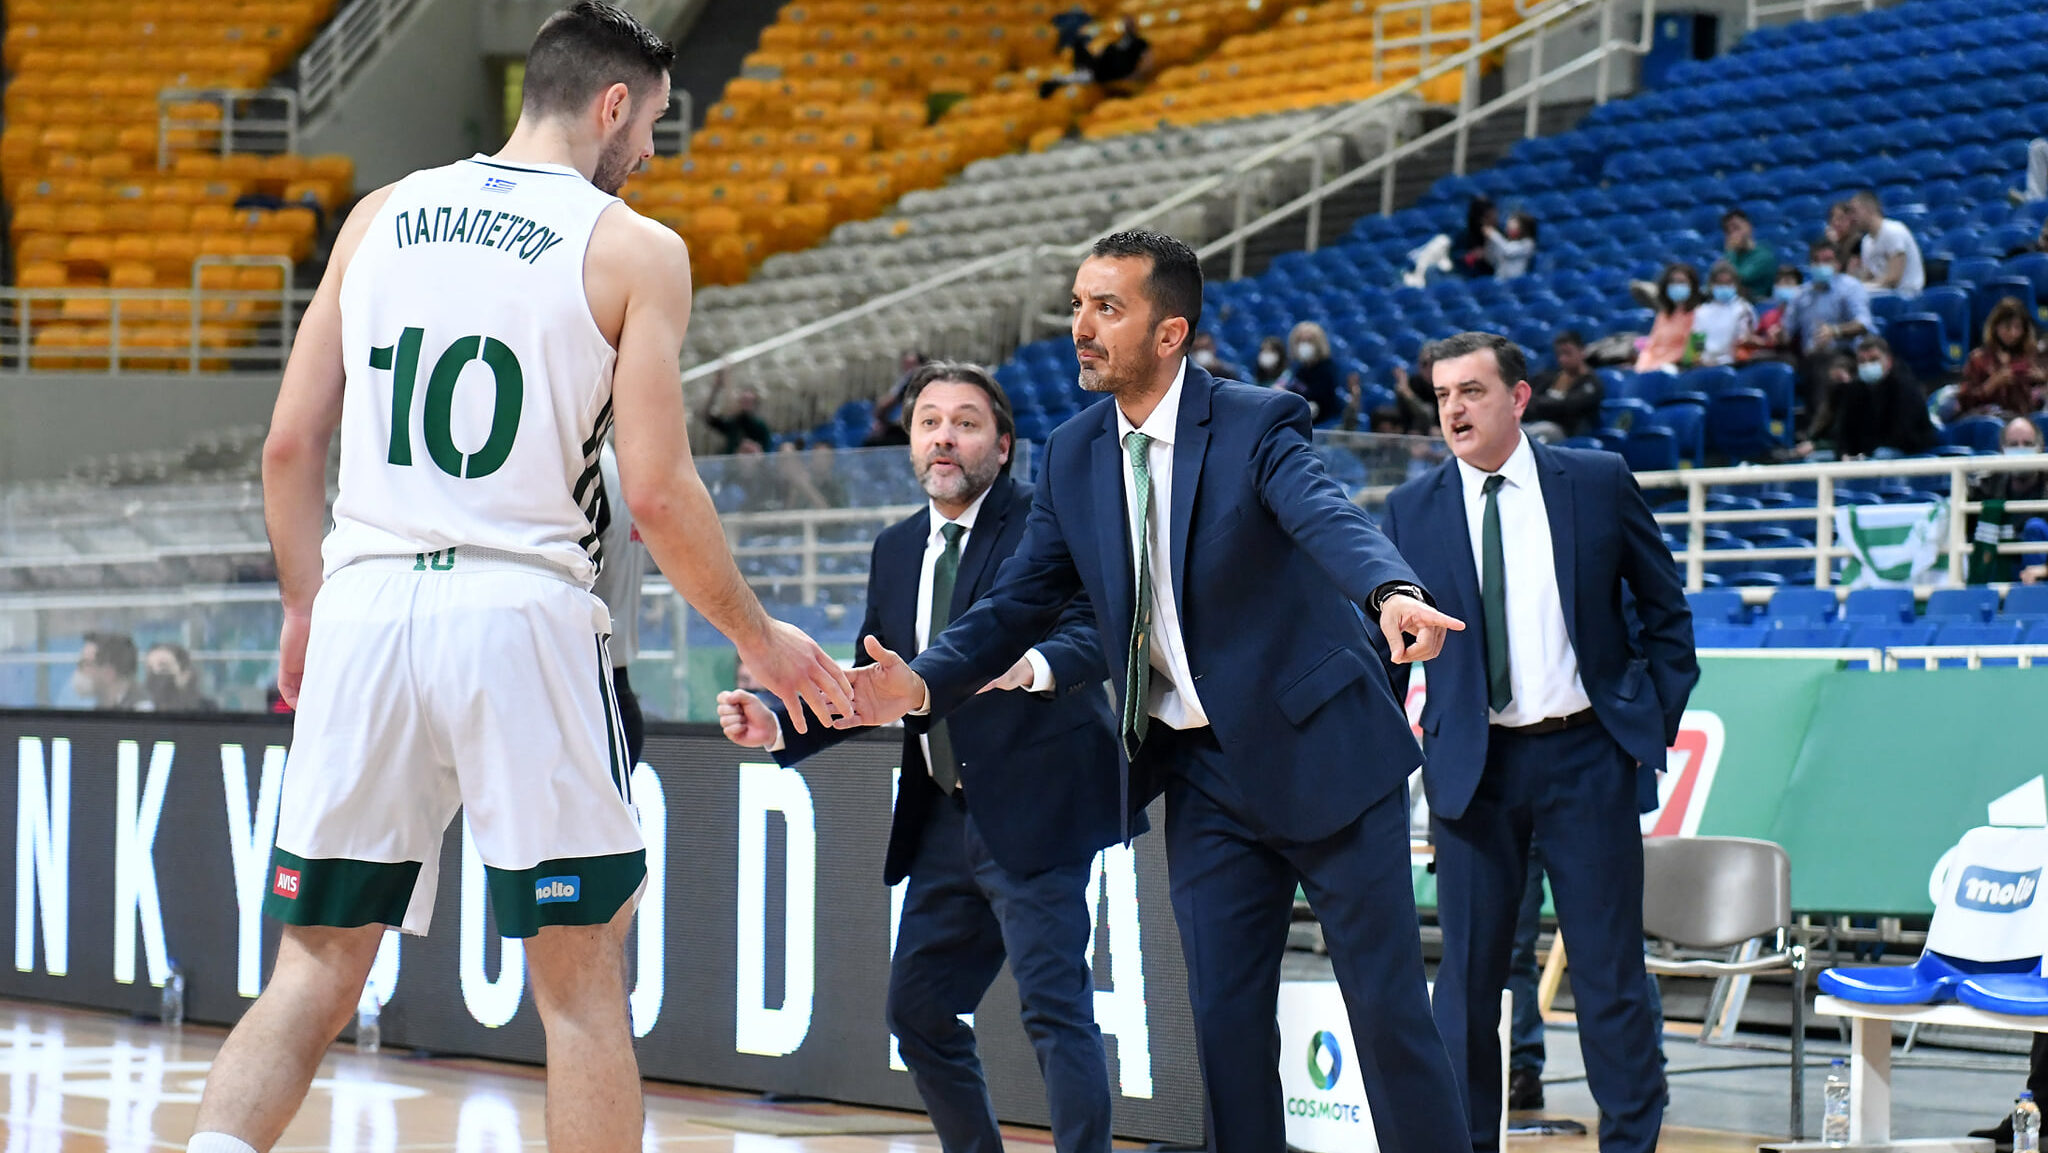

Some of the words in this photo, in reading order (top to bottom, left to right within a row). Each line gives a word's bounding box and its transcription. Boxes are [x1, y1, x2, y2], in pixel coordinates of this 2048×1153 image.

[396, 206, 563, 264] ΠΑΠΑΠΕΤΡΟΥ
[369, 326, 525, 479] 10
[277, 872, 298, 893] AVIS
[1287, 1097, 1361, 1124] COSMOTE
